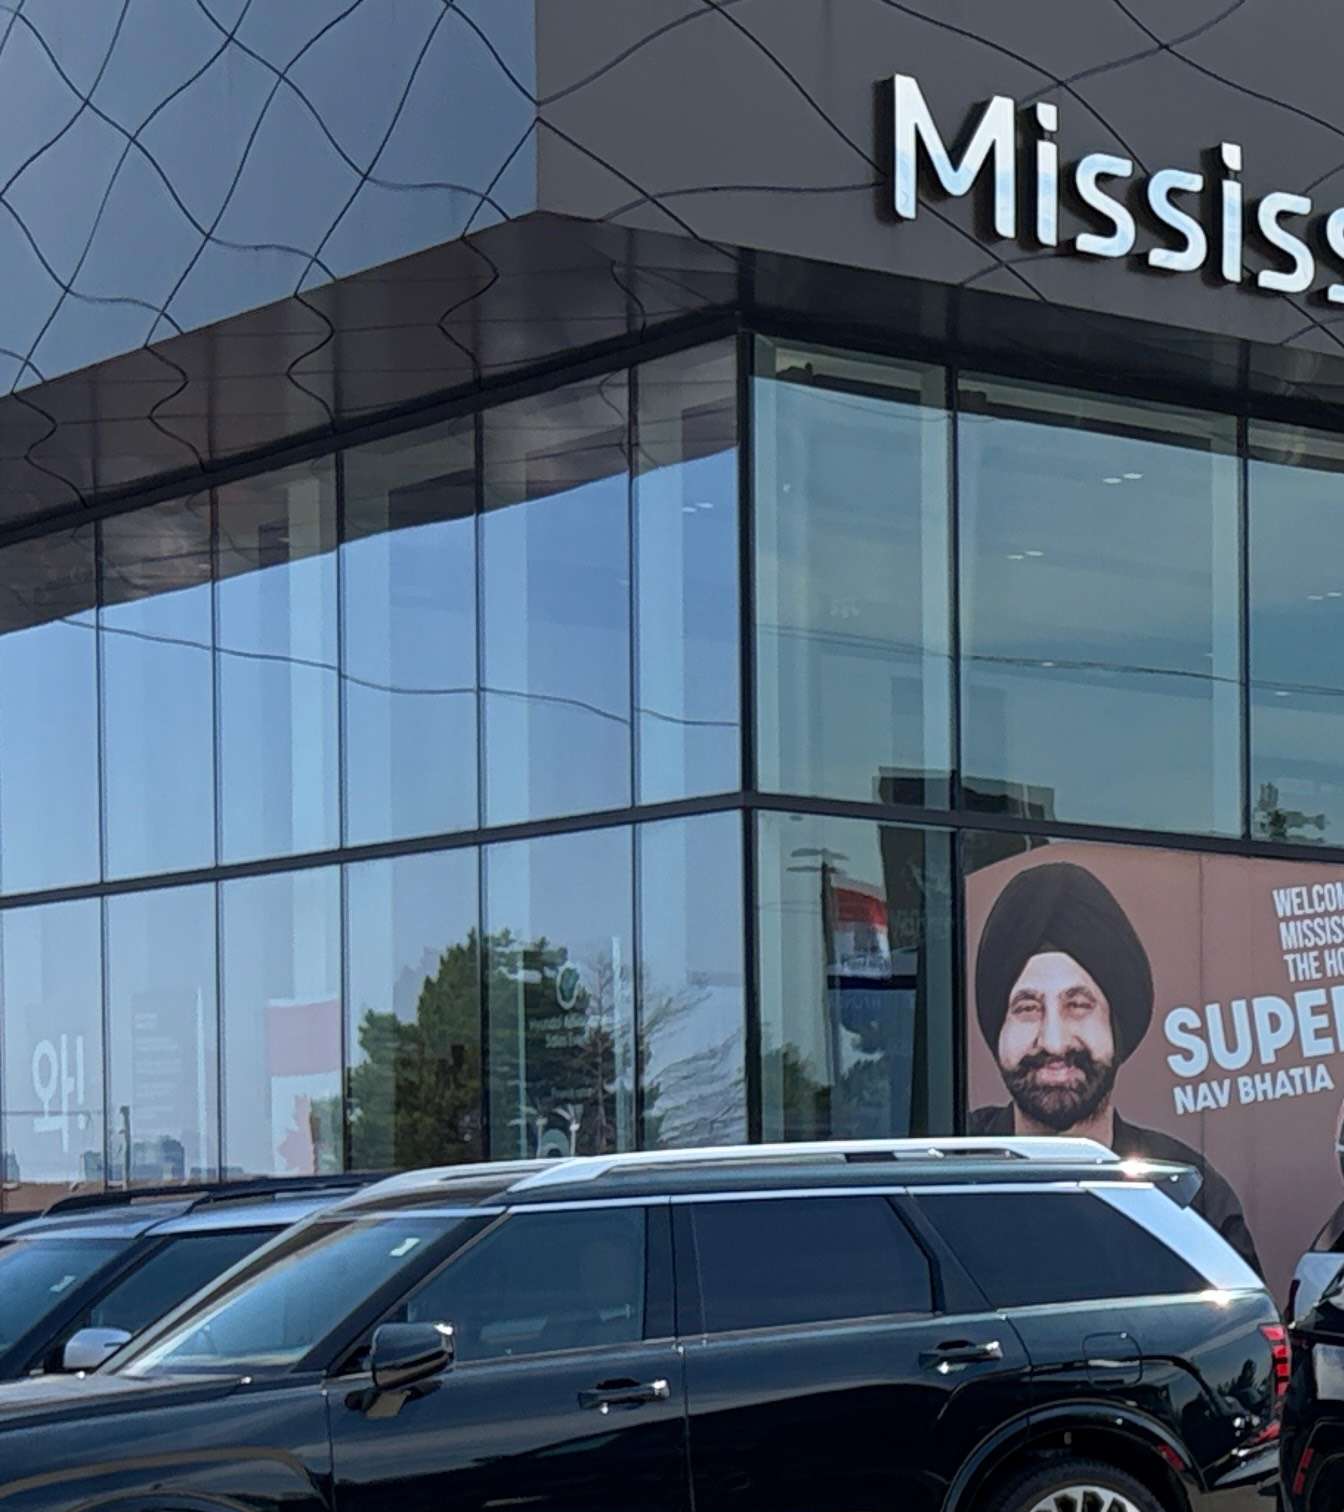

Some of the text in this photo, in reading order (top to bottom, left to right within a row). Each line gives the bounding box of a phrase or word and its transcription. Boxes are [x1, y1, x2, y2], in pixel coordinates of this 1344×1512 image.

[1283, 951, 1322, 982] THE
[1173, 1063, 1334, 1115] NAV BHATIA
